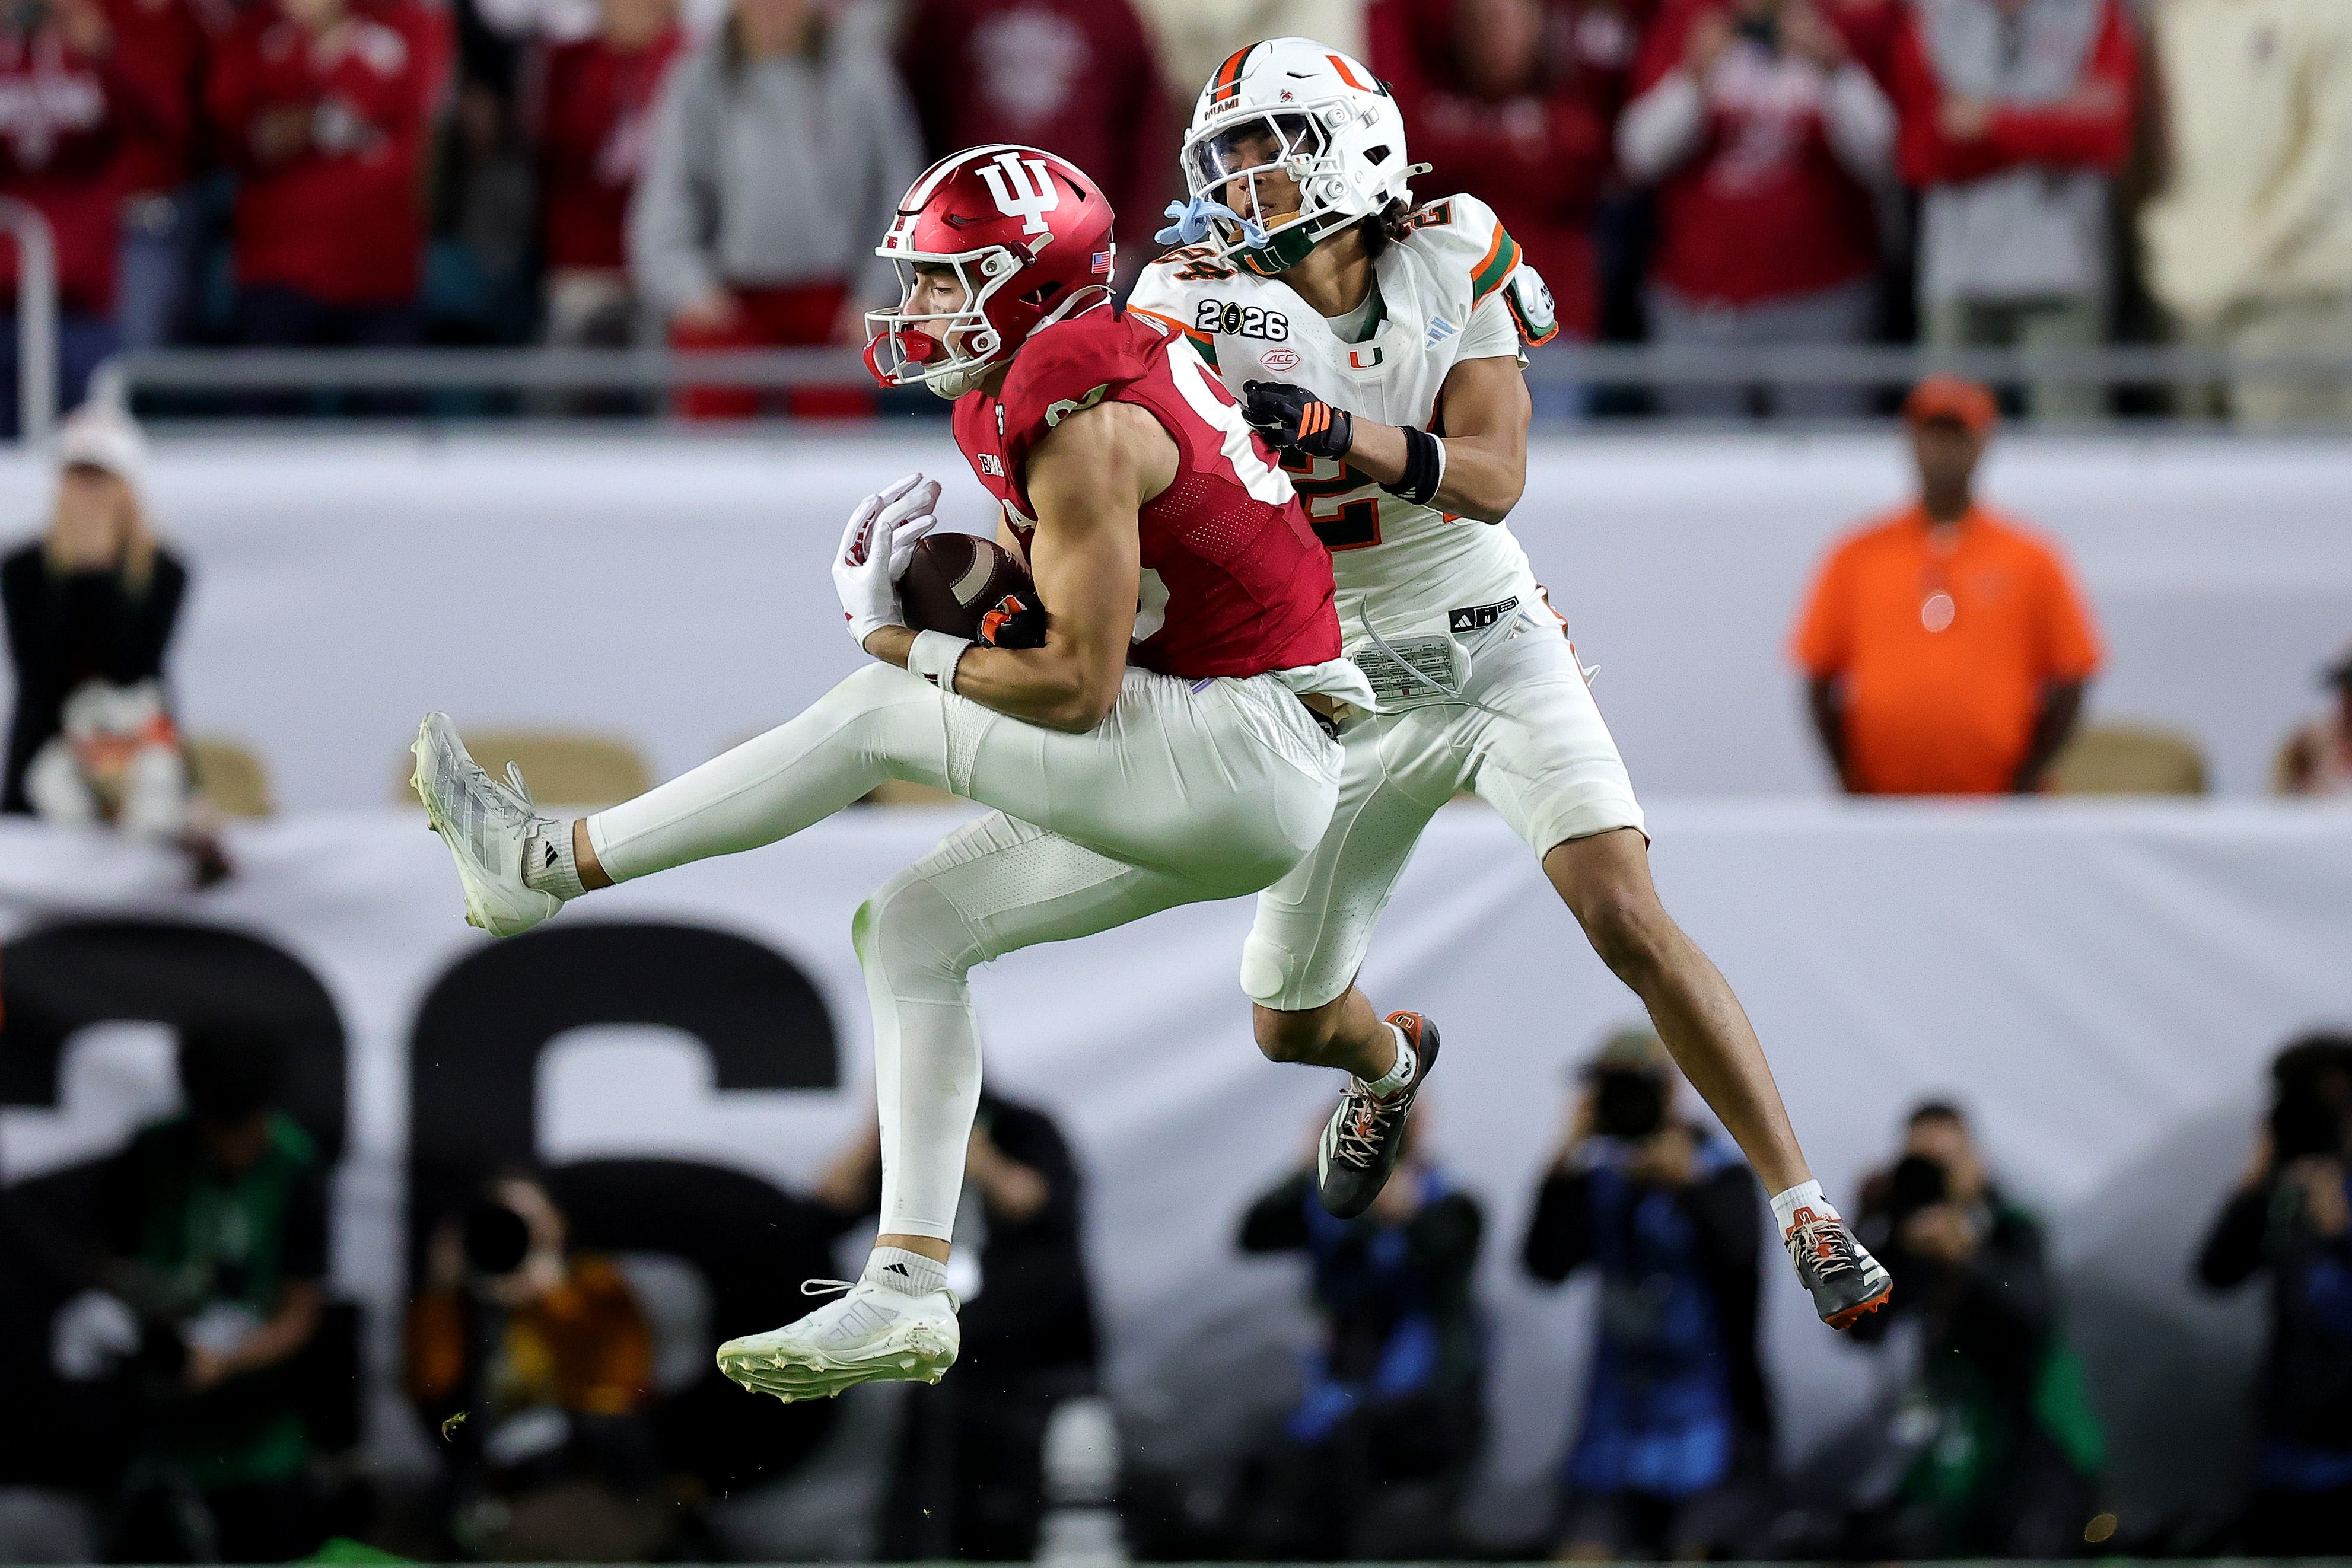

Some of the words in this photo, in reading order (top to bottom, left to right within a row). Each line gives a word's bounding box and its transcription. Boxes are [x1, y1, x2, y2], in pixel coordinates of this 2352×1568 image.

[1205, 98, 1239, 120] MIAMI
[1195, 299, 1288, 342] 2026
[1266, 353, 1294, 362] ACC
[1349, 346, 1383, 369] U
